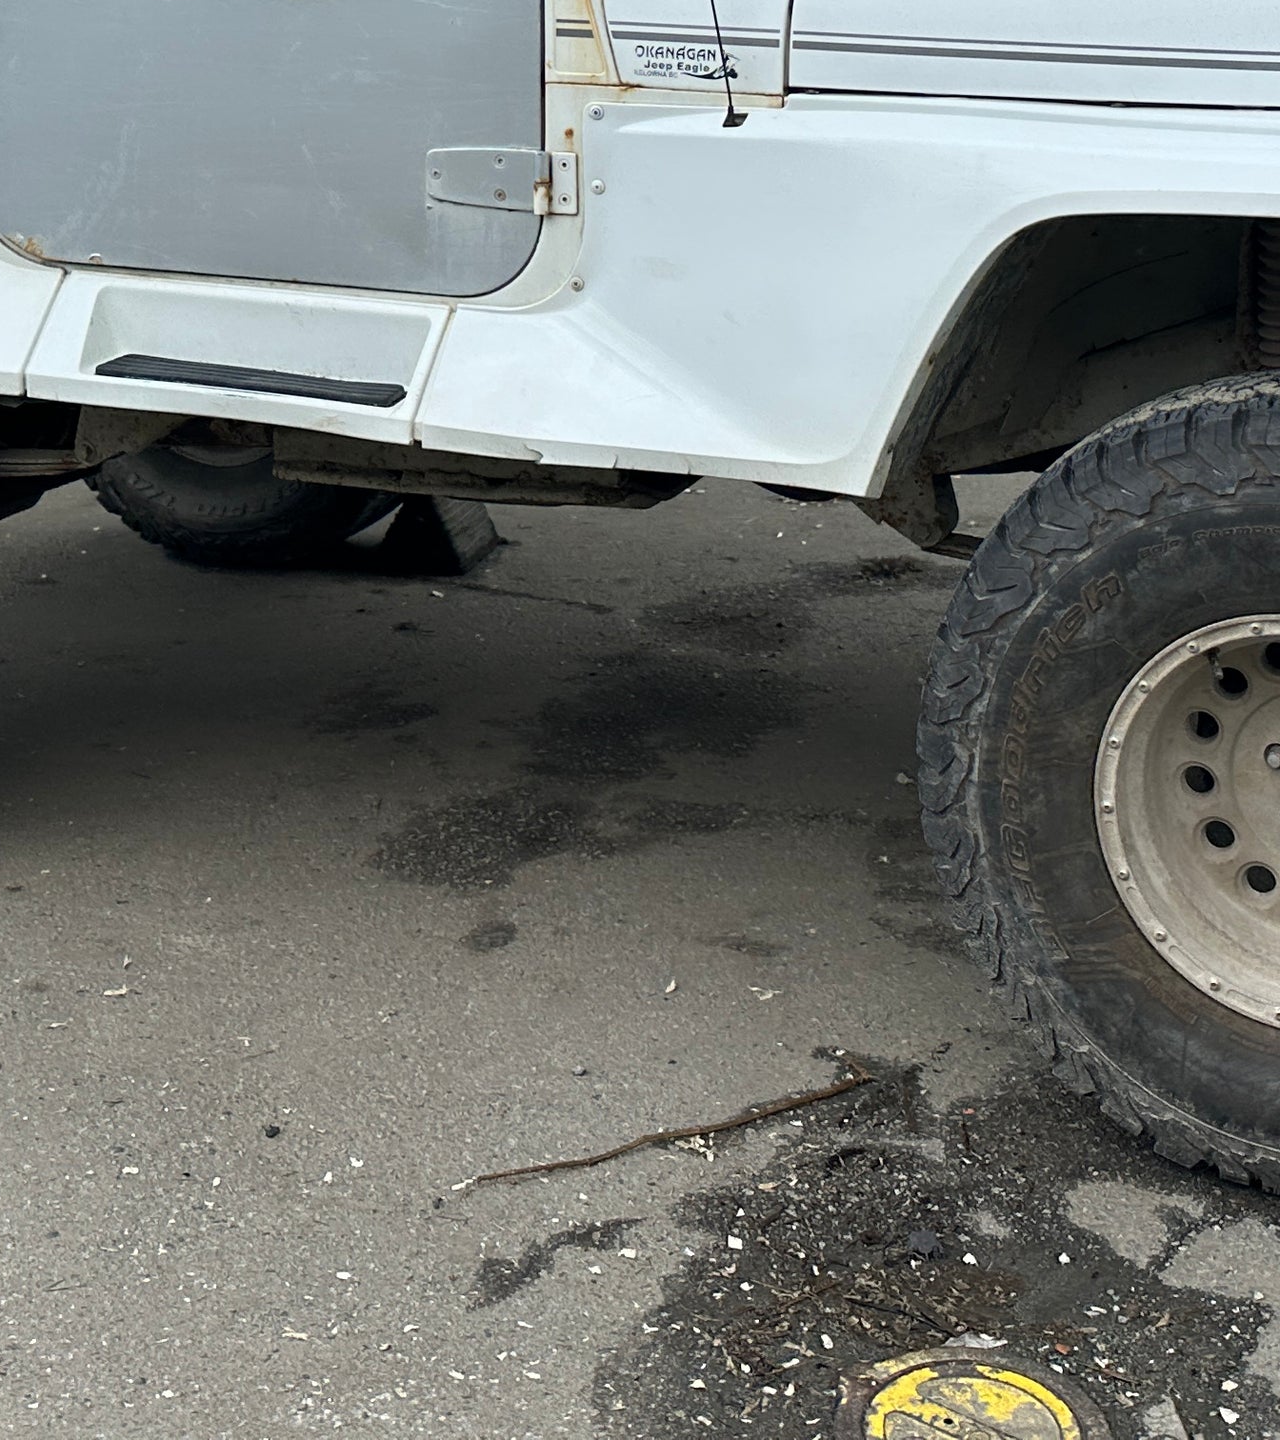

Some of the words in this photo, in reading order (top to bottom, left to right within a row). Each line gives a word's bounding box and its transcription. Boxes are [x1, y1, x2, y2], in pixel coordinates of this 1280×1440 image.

[635, 45, 717, 61] OKANAGAN
[644, 60, 673, 71] Jeep
[677, 62, 710, 73] Eagle
